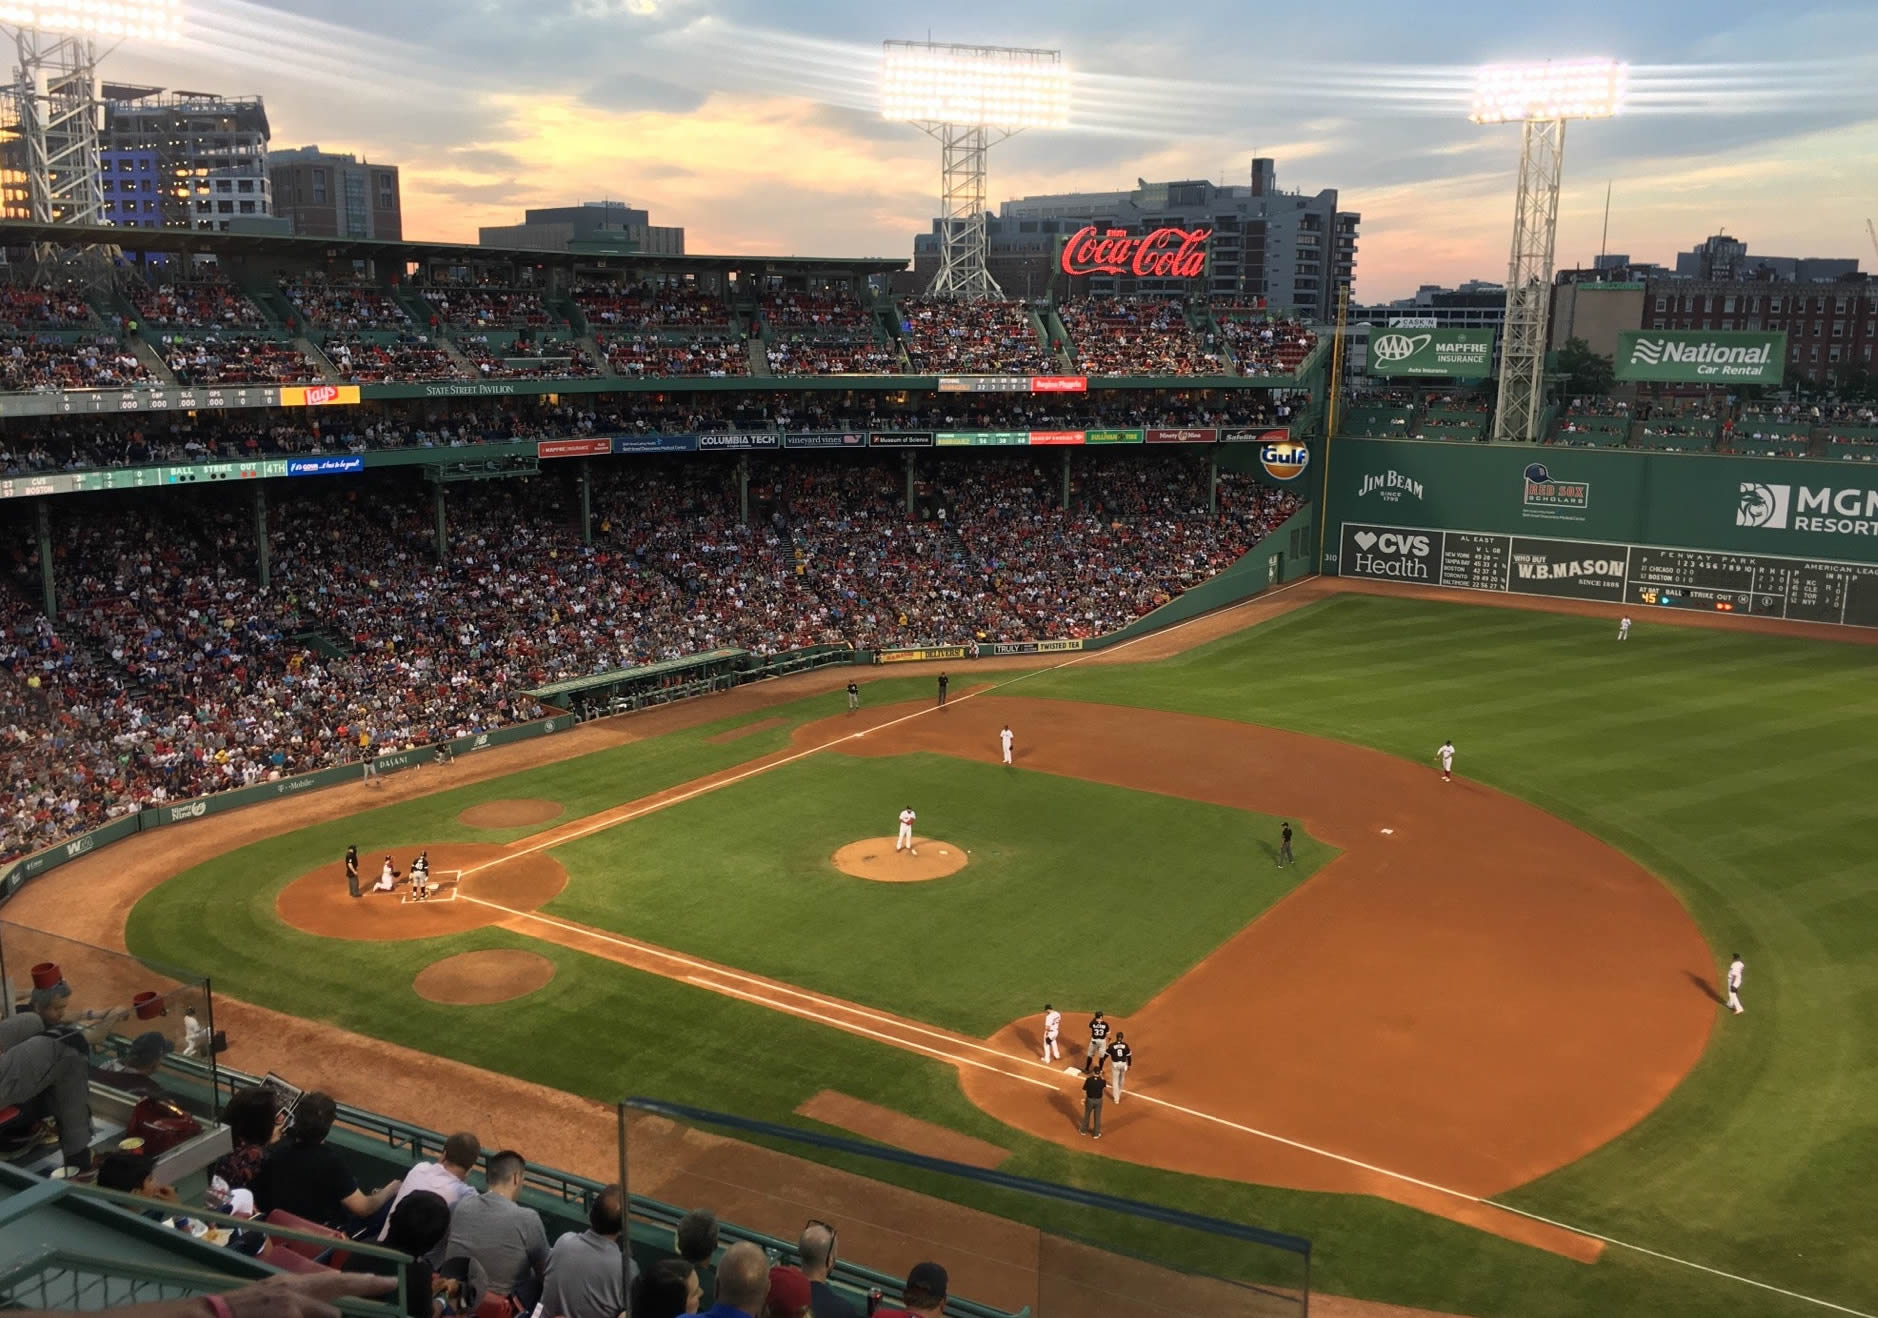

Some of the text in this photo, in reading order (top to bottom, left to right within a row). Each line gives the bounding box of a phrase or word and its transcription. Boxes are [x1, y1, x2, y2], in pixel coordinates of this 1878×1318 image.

[1062, 225, 1212, 277] Coca-Cola
[1435, 343, 1488, 353] MAPFRE
[1662, 341, 1772, 364] National
[1437, 355, 1484, 363] INSURANCE
[1697, 365, 1764, 375] Car Rental
[426, 384, 514, 396] STATE STREET PAVILION
[64, 403, 70, 411] 0
[120, 401, 137, 409] .000
[149, 400, 167, 408] .000
[178, 399, 196, 407] .000
[207, 398, 224, 406] .000
[240, 397, 246, 405] 0
[701, 435, 775, 446] COLUMBIA TECH
[787, 436, 842, 447] vineyard vines
[1263, 448, 1306, 464] Gulf
[267, 463, 285, 473] 4TH
[25, 486, 54, 495] BOSTON
[1359, 470, 1423, 500] JIM BEAM
[1528, 484, 1584, 498] RED SOX
[1379, 533, 1430, 556] CVS
[1325, 554, 1338, 562] 310
[1354, 553, 1428, 578] Health
[1649, 566, 1674, 574] CHICAGO
[1805, 563, 1852, 573] AMERICAN
[1648, 573, 1673, 582] BOSTON
[1641, 593, 1656, 604] 45
[1665, 588, 1682, 596] BALL
[1690, 591, 1714, 599] STRIKE
[997, 645, 1019, 653] TRULY
[380, 757, 407, 768] DASANI
